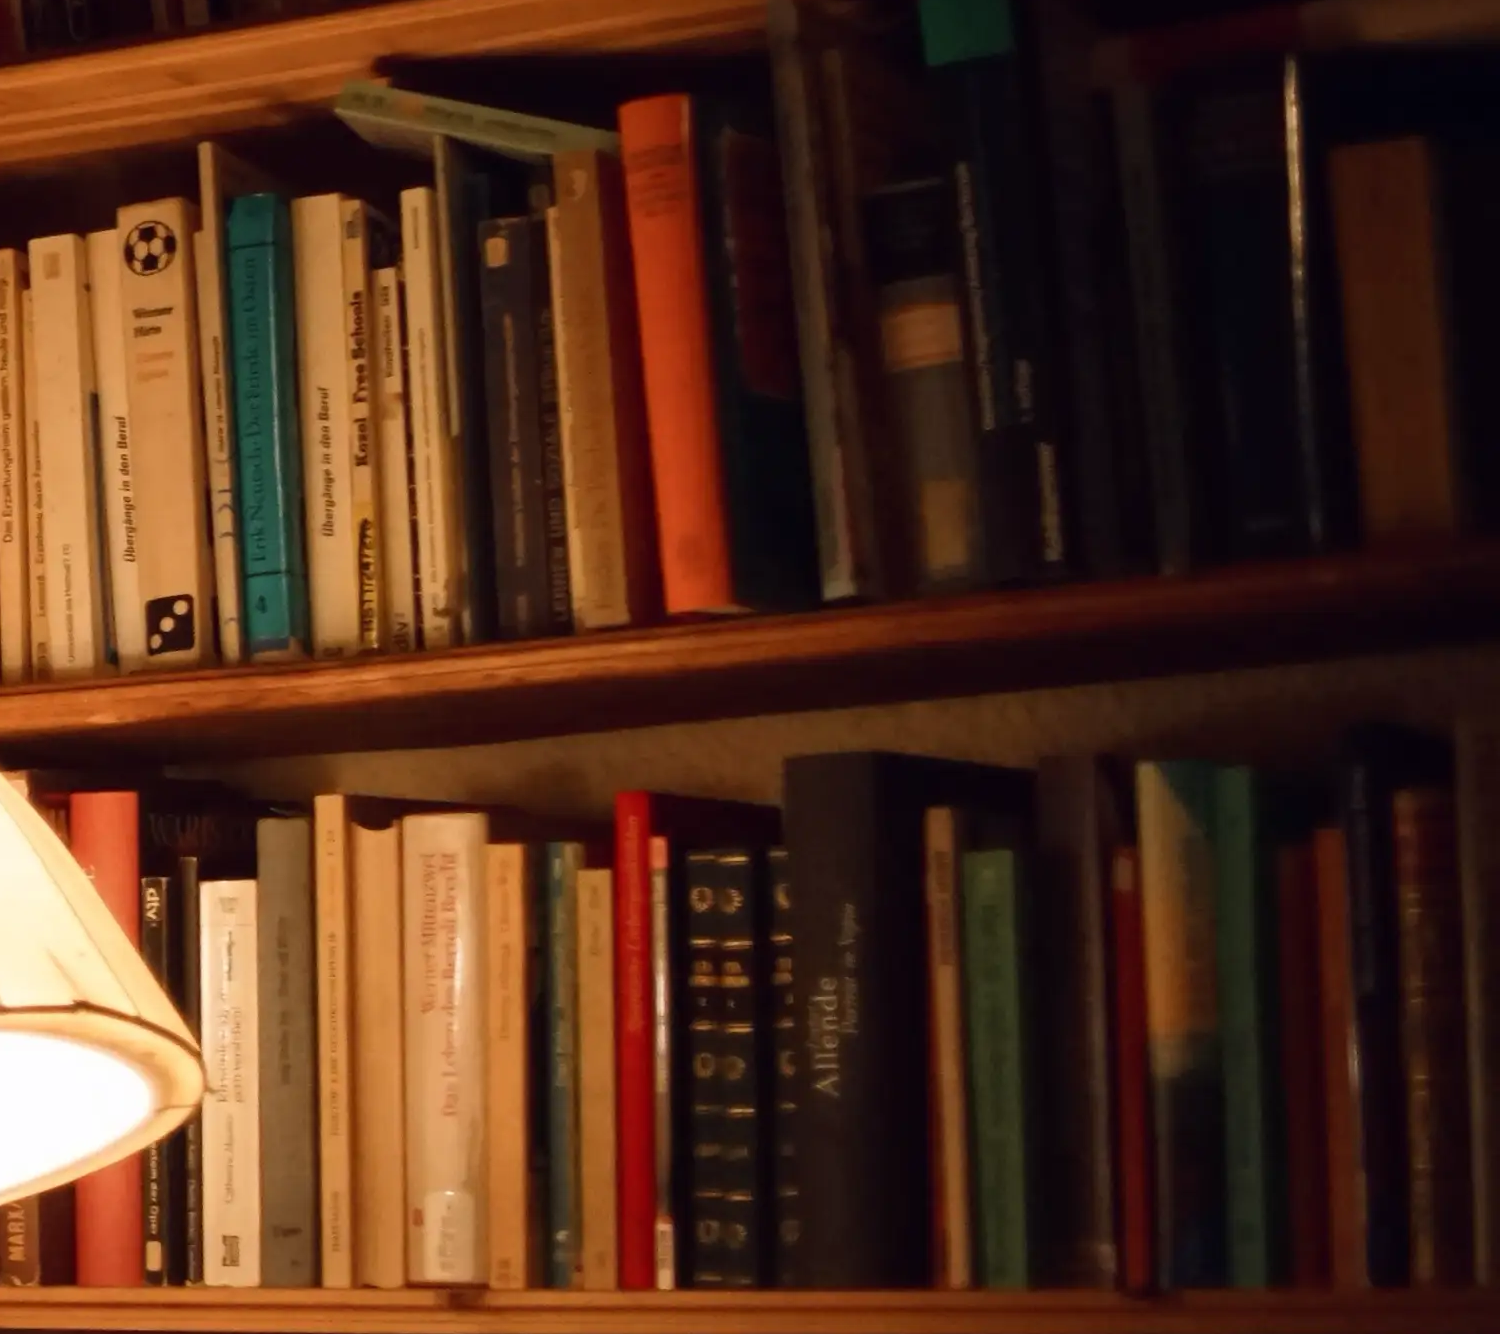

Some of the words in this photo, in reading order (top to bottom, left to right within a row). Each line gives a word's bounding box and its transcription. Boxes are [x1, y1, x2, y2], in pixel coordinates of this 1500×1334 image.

[239, 257, 259, 314] Osten
[242, 316, 259, 340] im
[348, 290, 367, 359] Schools
[241, 343, 262, 400] Friede
[351, 362, 368, 405] Free
[243, 401, 263, 439] Der
[316, 386, 331, 422] Beruf
[114, 415, 130, 451] Beruf
[317, 425, 331, 449] den
[352, 416, 370, 467] Kozol
[116, 453, 130, 476] den
[318, 451, 332, 466] in
[118, 479, 131, 494] in
[245, 445, 266, 521] Neutsch
[319, 467, 336, 538] Übergänge
[120, 495, 138, 564] Übergänge
[247, 524, 267, 563] Erik
[144, 887, 161, 922] dtv
[418, 852, 437, 948] Mittenzwei
[439, 852, 458, 913] Brecht
[440, 916, 458, 980] Bertolt
[419, 952, 438, 1015] Werner
[440, 983, 459, 1018] des
[440, 1022, 459, 1078] Leben
[811, 976, 840, 1098] Allende
[440, 1082, 459, 1119] Das
